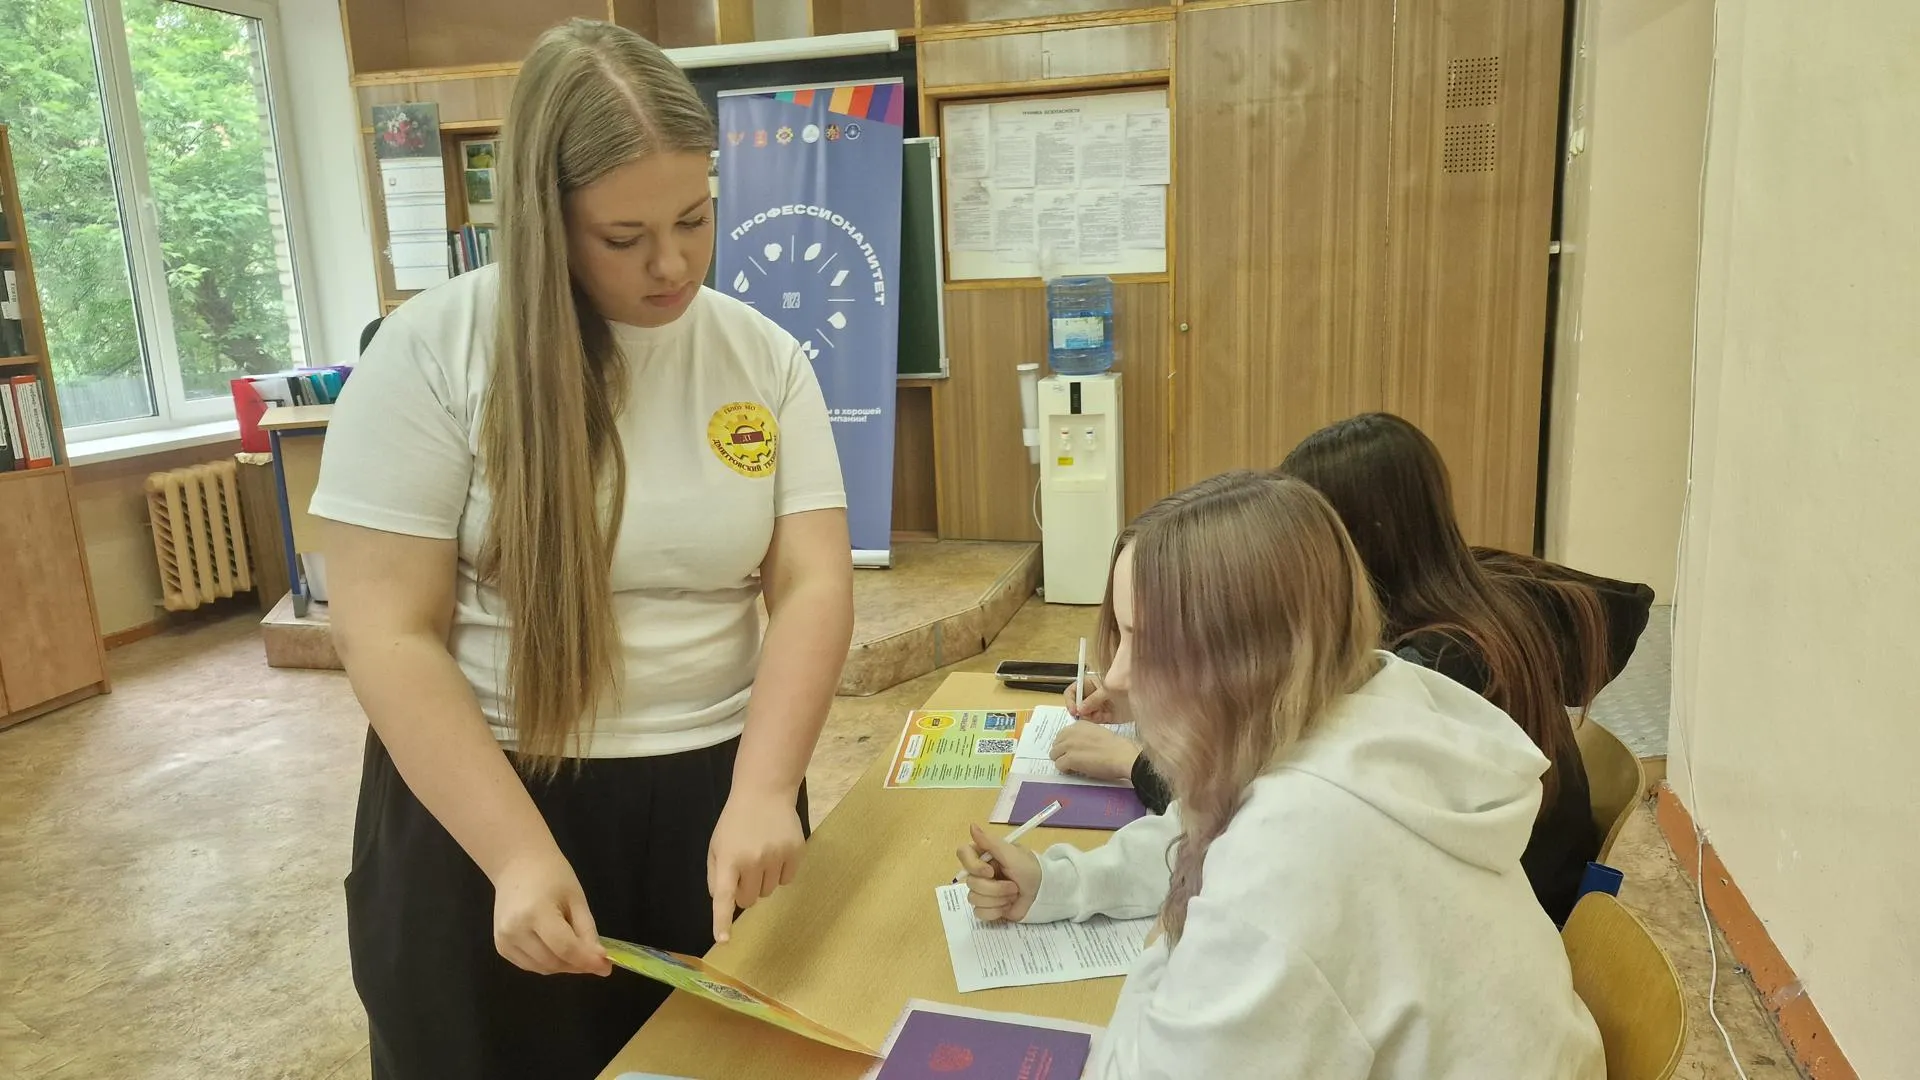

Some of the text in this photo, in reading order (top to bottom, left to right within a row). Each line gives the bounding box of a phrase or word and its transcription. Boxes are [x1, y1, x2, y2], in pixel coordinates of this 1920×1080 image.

[730, 204, 885, 306] ПРОФЕССИОНАЛИТЕТ
[782, 292, 801, 309] 2023
[829, 415, 868, 423] мпании!
[841, 406, 882, 417] хорошей
[711, 438, 763, 473] ДМИТРОВСКИЙ
